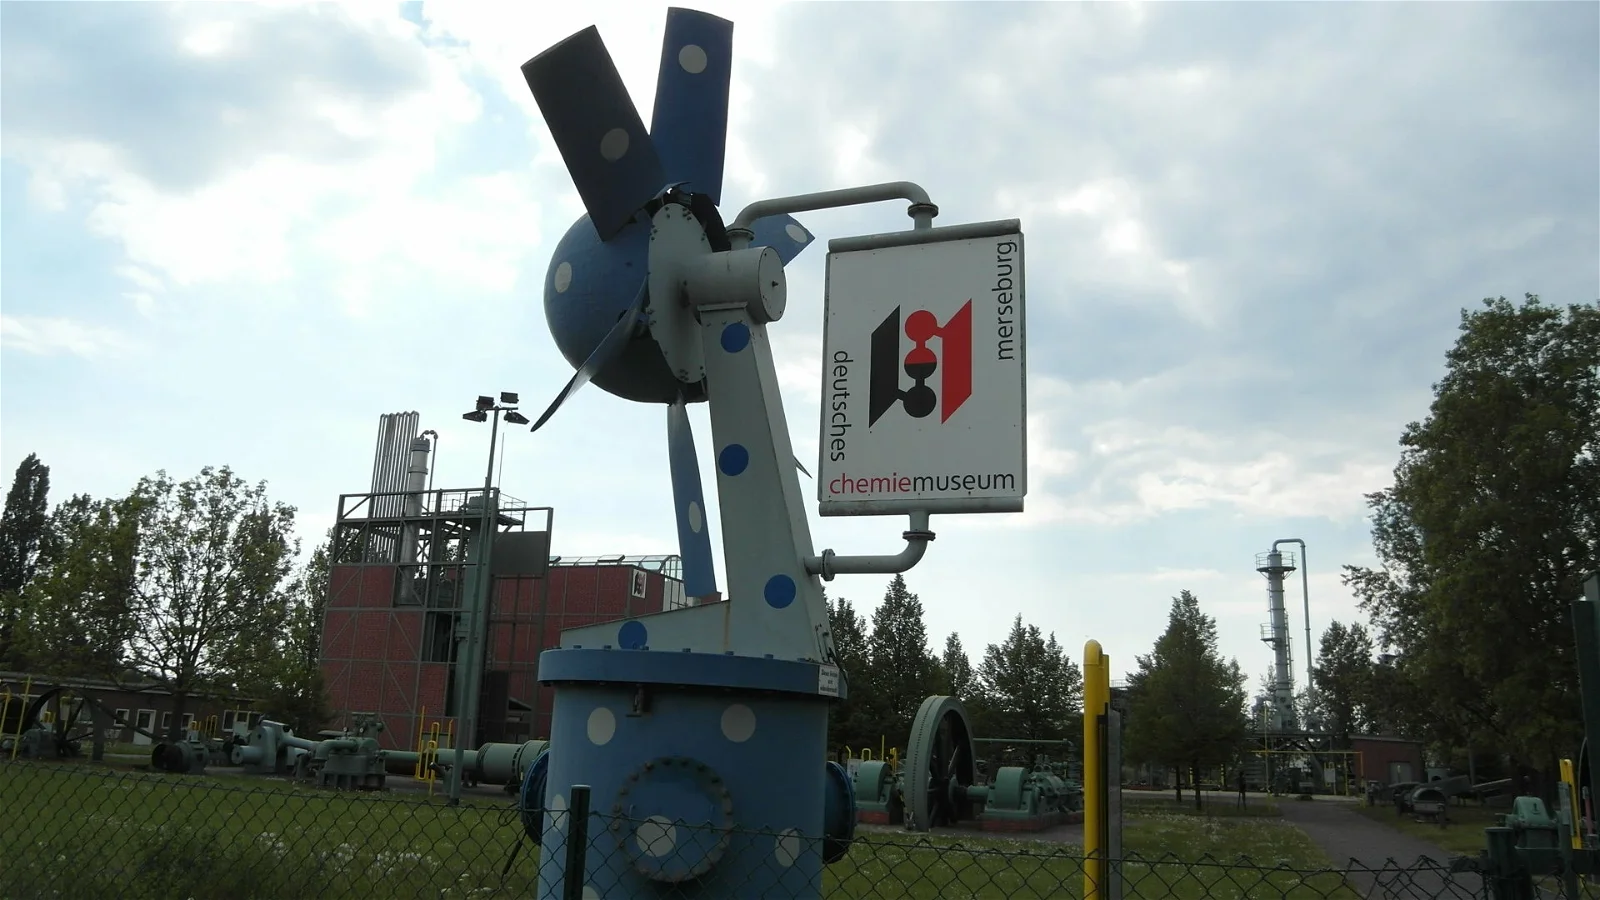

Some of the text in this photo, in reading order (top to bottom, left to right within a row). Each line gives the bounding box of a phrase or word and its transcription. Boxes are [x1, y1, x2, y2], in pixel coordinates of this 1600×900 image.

[991, 241, 1017, 361] merseburg
[830, 350, 854, 461] deutsches
[829, 472, 1015, 494] chemiemuseum
